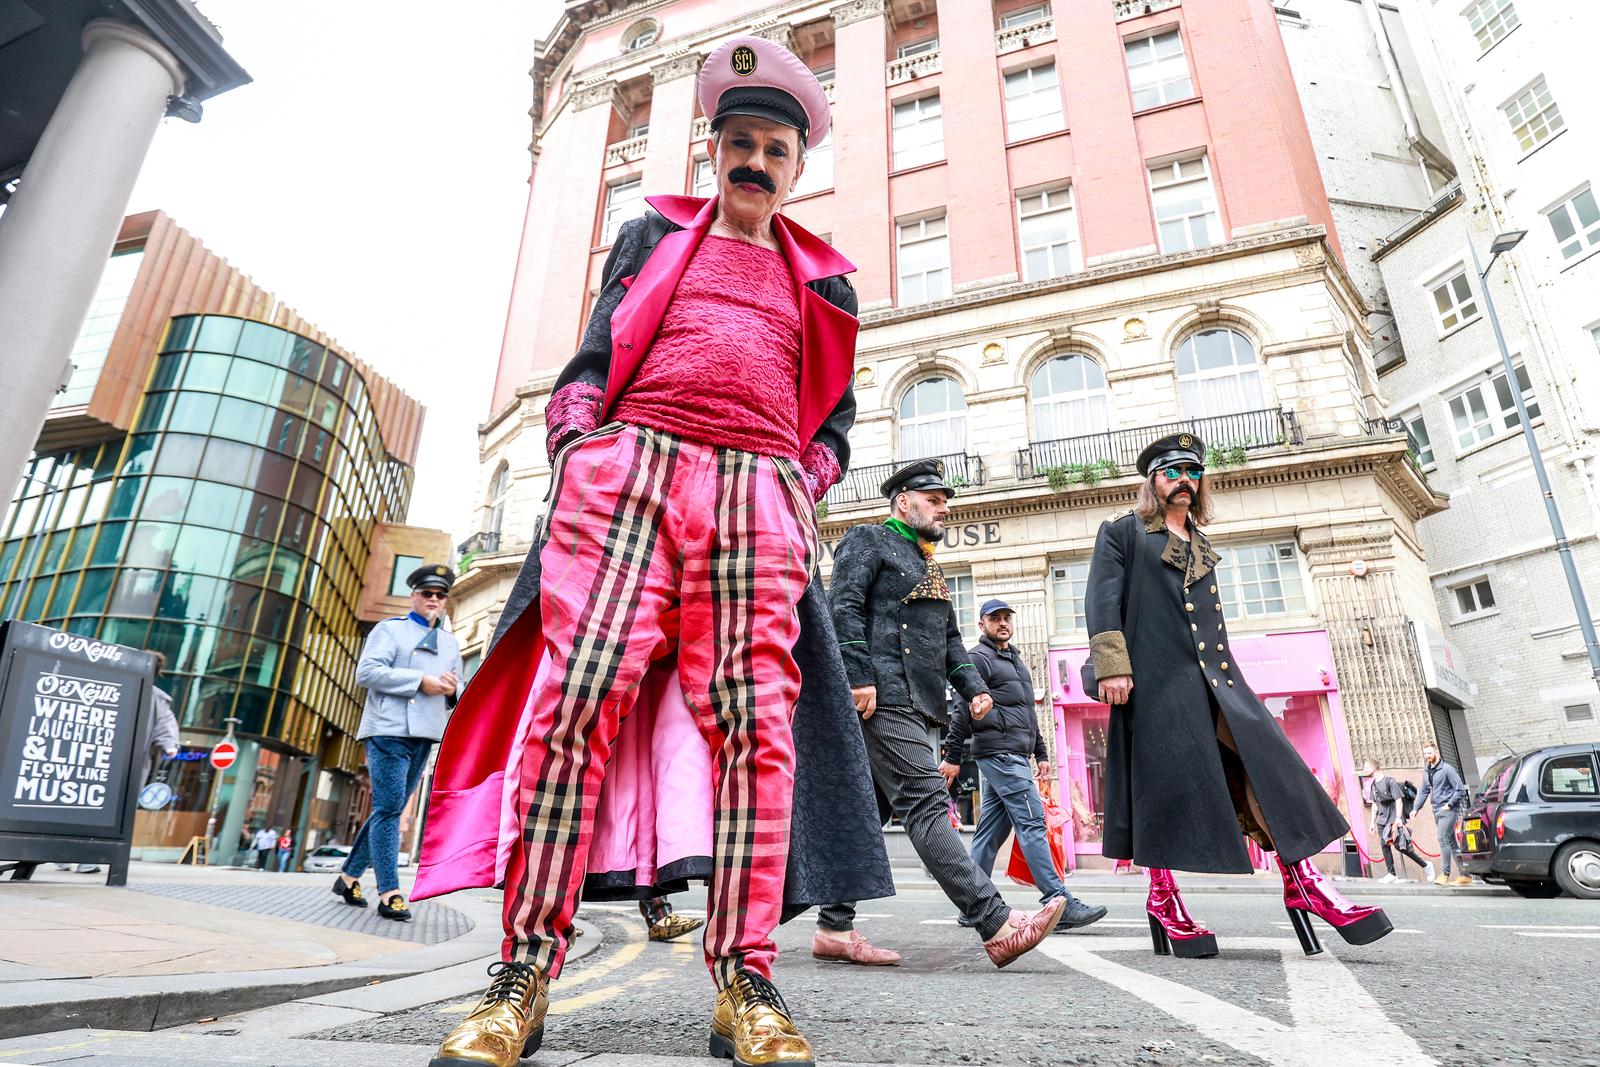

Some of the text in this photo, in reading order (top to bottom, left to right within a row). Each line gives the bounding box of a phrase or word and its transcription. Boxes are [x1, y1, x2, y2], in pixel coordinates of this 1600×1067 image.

[943, 521, 1001, 548] USE
[34, 697, 118, 729] WHERE
[28, 716, 115, 746] LAUGHTER
[22, 736, 113, 769] & LIFE
[19, 760, 110, 782] FLOW LIKE
[14, 776, 106, 806] MUSIC
